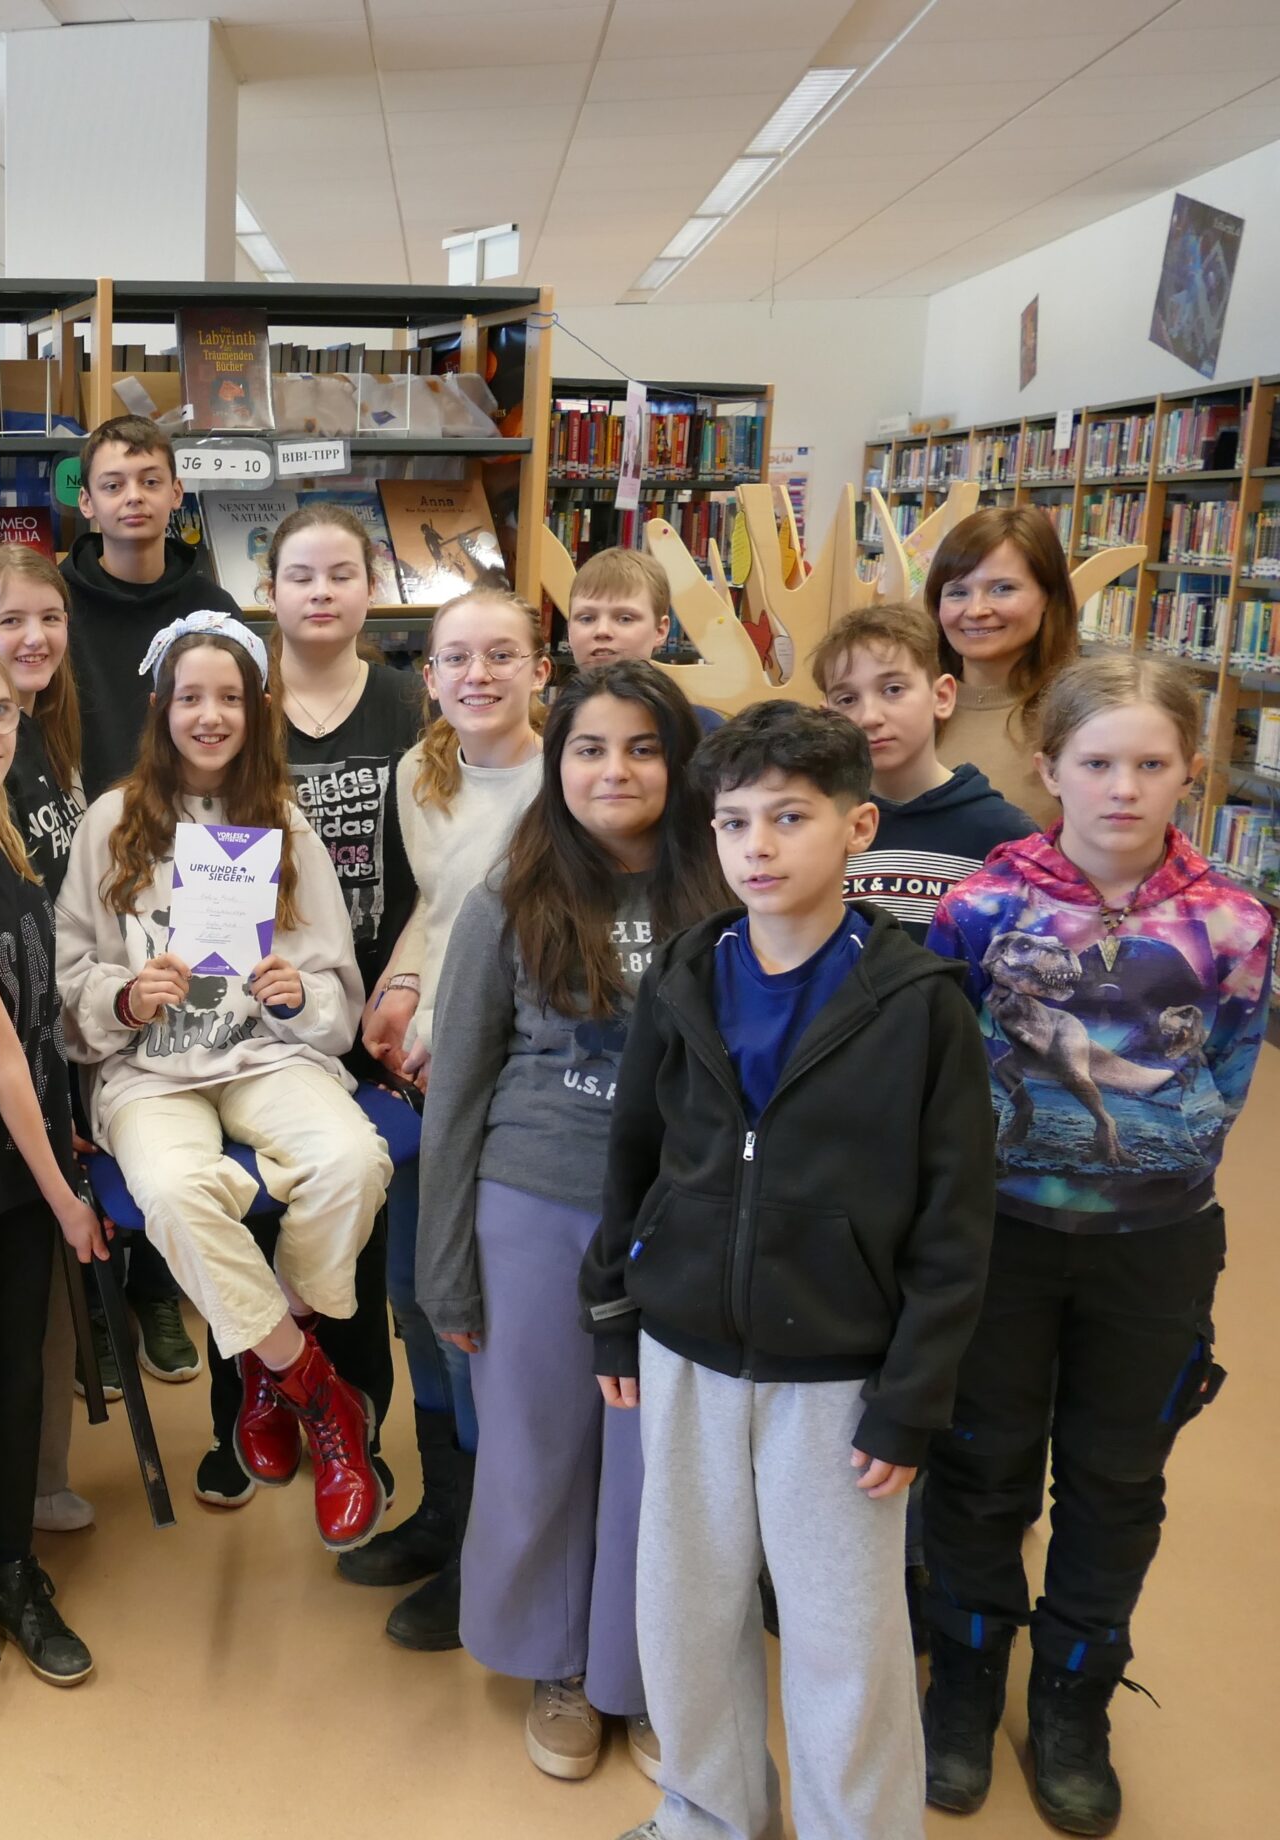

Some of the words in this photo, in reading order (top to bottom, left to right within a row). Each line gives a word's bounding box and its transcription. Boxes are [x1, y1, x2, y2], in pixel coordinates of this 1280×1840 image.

[198, 330, 256, 348] Labyrinth
[282, 448, 340, 463] BIBI-TIPP
[182, 456, 202, 470] JG
[214, 458, 223, 471] 9
[244, 460, 261, 472] 10
[218, 503, 256, 512] NENNT
[257, 503, 286, 512] MICH
[420, 495, 454, 507] Anna
[231, 513, 280, 522] NATHAN
[2, 531, 40, 543] JULIA
[297, 768, 377, 807] didas
[310, 816, 375, 838] idas
[189, 863, 238, 874] URKUNDE
[870, 877, 884, 892] &
[890, 878, 956, 896] JON
[563, 1069, 602, 1097] U.S.
